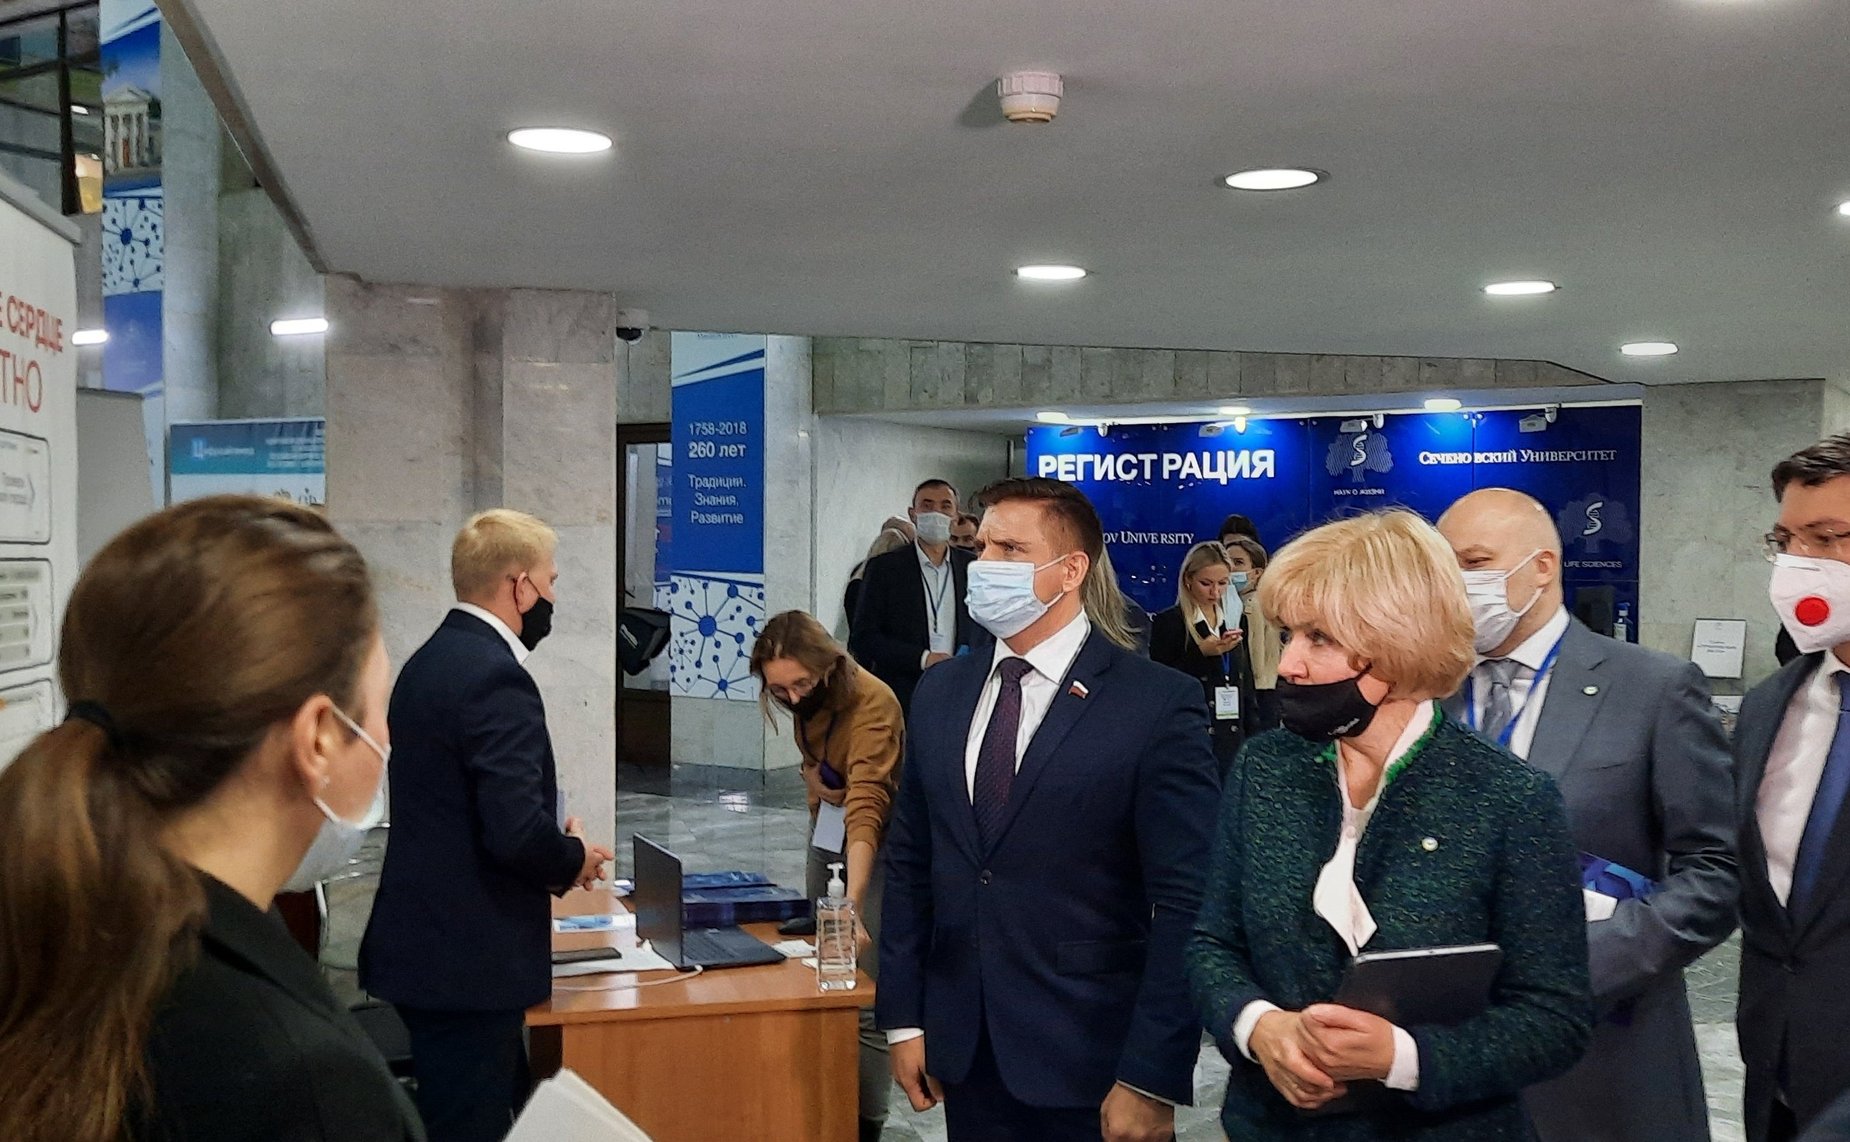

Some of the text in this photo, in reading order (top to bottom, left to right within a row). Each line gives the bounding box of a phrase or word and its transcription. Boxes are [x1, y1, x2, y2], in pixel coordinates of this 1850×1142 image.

[7, 295, 63, 355] СЕРДЦЕ
[689, 421, 747, 436] 1758-2018
[688, 441, 747, 458] 260 лет
[690, 510, 744, 524] Развитие
